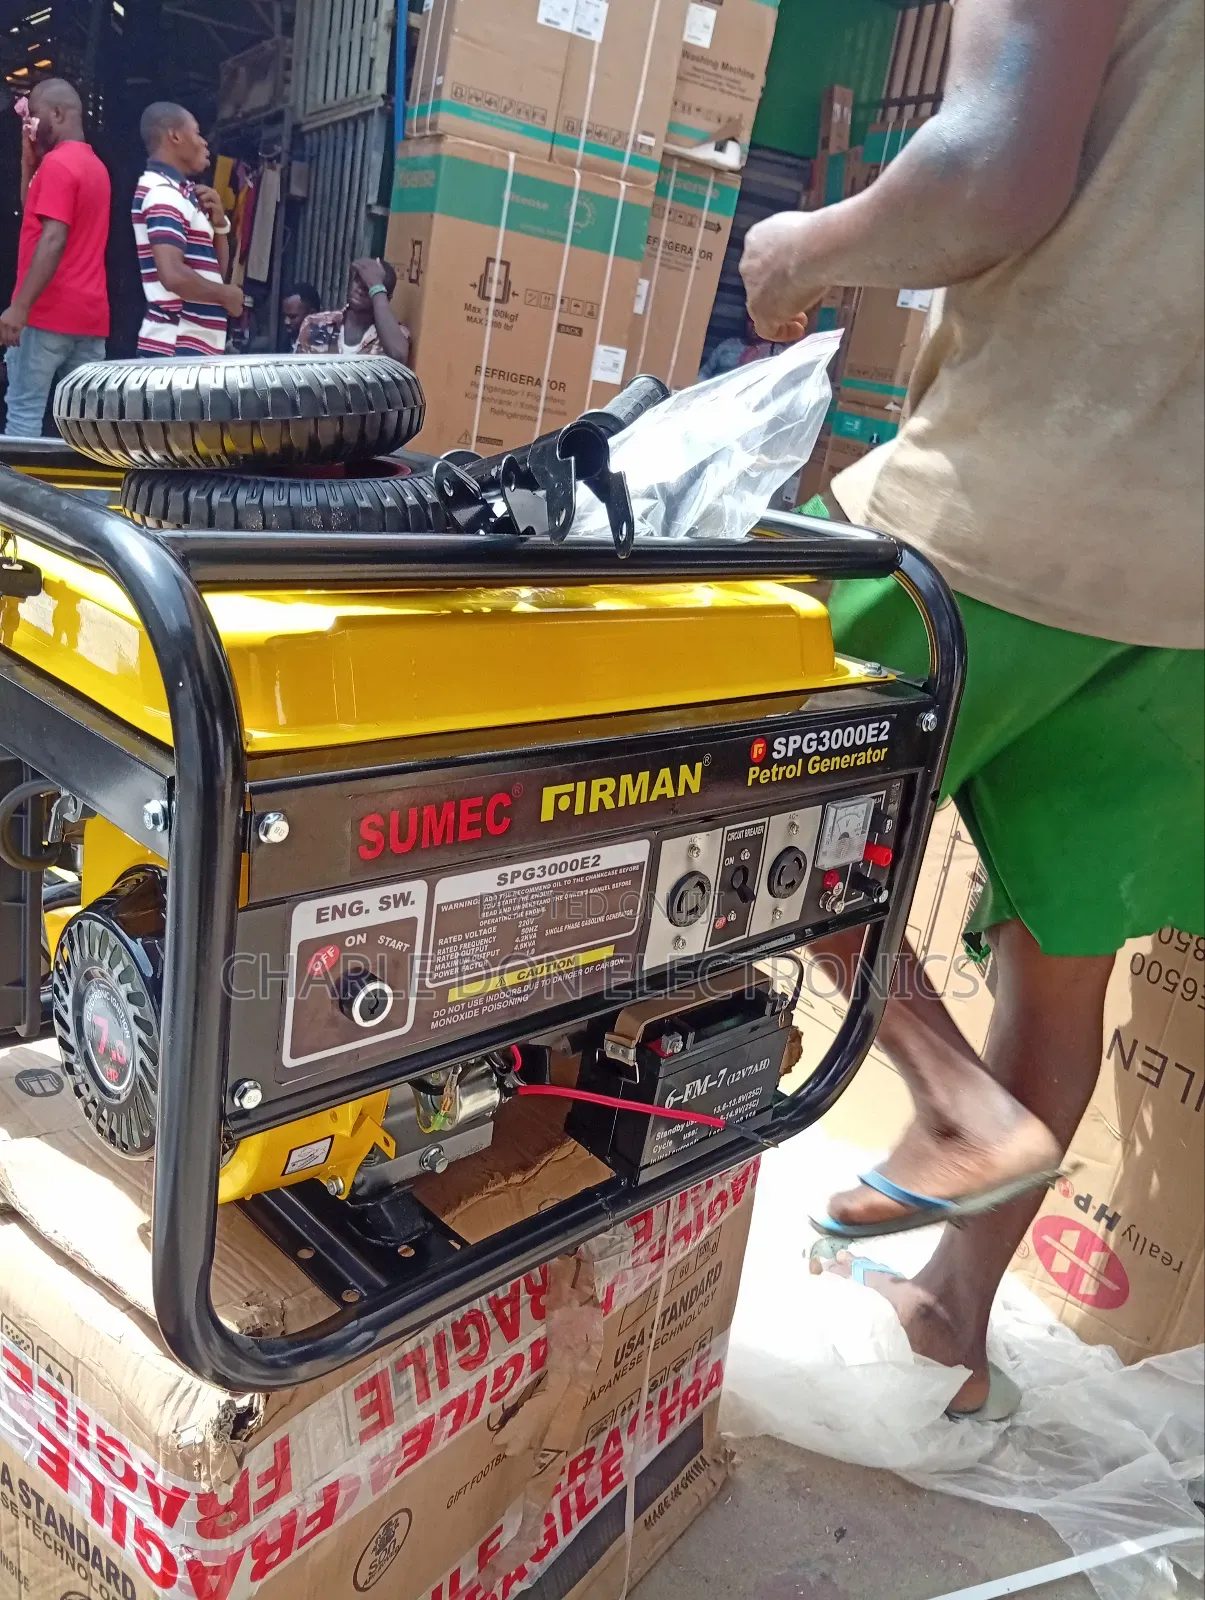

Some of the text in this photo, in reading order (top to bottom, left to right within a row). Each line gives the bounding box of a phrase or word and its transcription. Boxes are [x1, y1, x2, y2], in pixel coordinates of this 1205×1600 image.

[464, 303, 481, 315] Max
[466, 315, 483, 326] MAX
[559, 325, 582, 337] BACK
[772, 720, 890, 760] SPG3000E2
[747, 746, 888, 787] Petrol Generator
[540, 762, 704, 823] FIRMAN
[357, 792, 513, 860] SUMEC
[745, 825, 764, 838] BREAKER
[496, 854, 601, 887] SPG3000E2
[619, 864, 640, 874] BEFORE
[725, 857, 735, 866] ON
[612, 880, 632, 889] BEFORE
[315, 891, 415, 924] ENG. SW.
[345, 933, 367, 947] ON
[438, 918, 535, 946] RATED VOLTAGE 220V
[563, 921, 581, 932] PHASE
[378, 935, 410, 952] START
[436, 952, 462, 963] RATED
[460, 945, 489, 957] OUTPUT
[437, 944, 458, 956] RATED
[459, 936, 497, 950] FREQUENCY
[471, 949, 501, 961] OUTPUT
[311, 945, 335, 972] OFF
[517, 956, 577, 981] CAUTION
[433, 967, 459, 980] POWER
[433, 957, 625, 1019] DO NOT USE INDOORS DUE TO DANGER OF CARBON
[86, 989, 131, 1039] ELECTRONIC IGNITION
[430, 994, 529, 1030] MONOXIDE POISONING
[664, 1057, 770, 1109] 6-FM-7 (12V7AH)
[656, 1122, 685, 1141] Standby
[652, 1140, 673, 1154] Cycle
[1121, 1223, 1184, 1275] really
[613, 1327, 646, 1369] USA
[582, 1351, 643, 1411] JAPANESE
[446, 1482, 470, 1510] GIFT
[643, 1497, 672, 1532] MADE
[680, 1454, 711, 1490] CHINA
[18, 1477, 137, 1600] STANDARD
